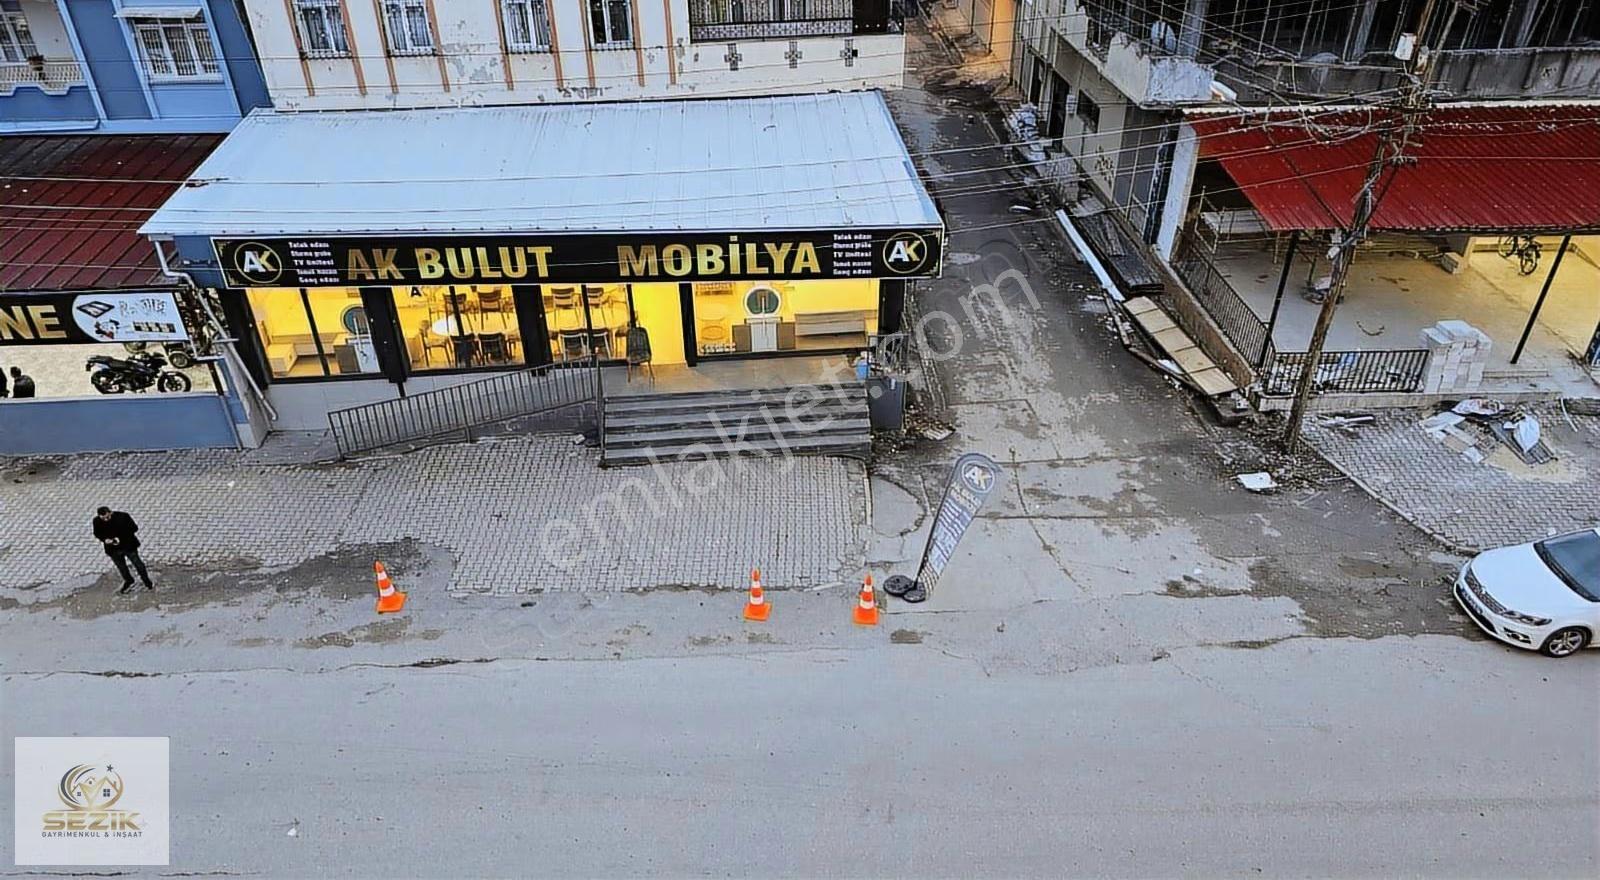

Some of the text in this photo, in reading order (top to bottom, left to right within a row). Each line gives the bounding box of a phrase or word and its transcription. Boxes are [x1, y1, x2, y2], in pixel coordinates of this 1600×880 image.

[243, 250, 278, 273] AK
[347, 235, 821, 280] AK BULUT MOBİLYA
[887, 241, 921, 263] AK
